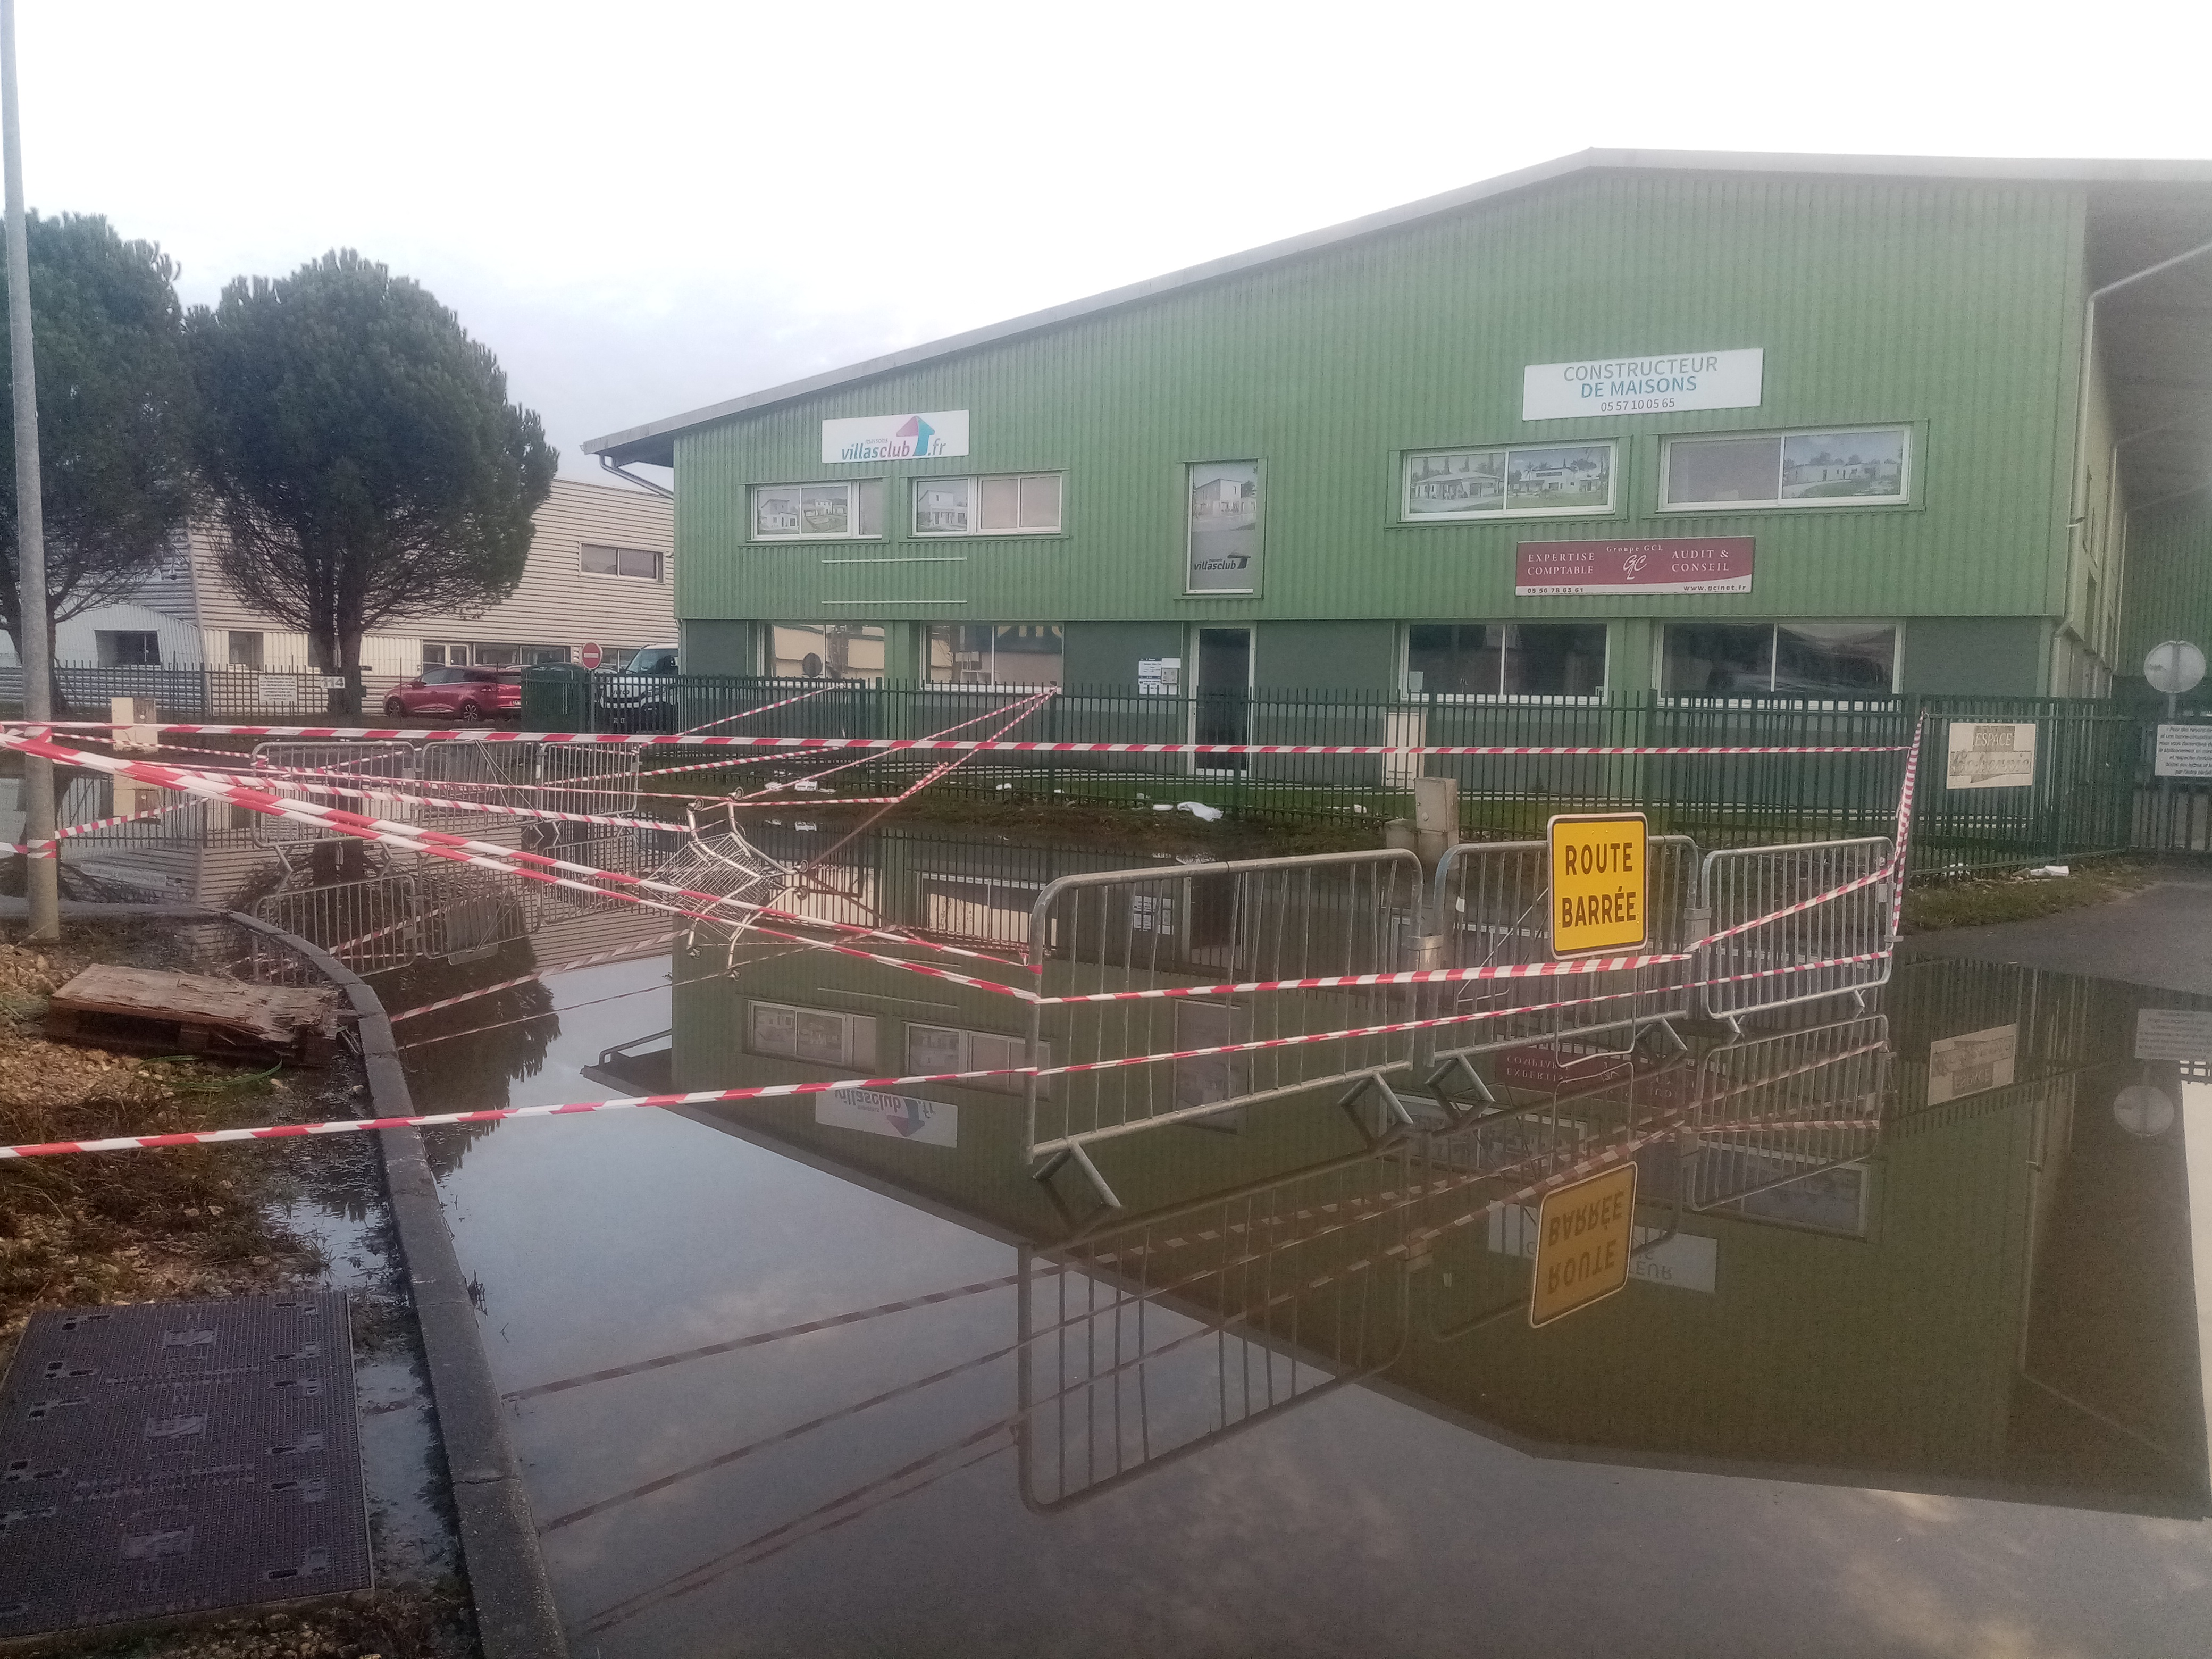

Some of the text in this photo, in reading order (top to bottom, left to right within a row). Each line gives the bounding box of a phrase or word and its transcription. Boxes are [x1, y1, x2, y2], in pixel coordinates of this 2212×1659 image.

[1563, 356, 1718, 381] CONSTRUCTEUR
[1581, 376, 1697, 398] DE MAISONS
[1601, 398, 1674, 412] 05 57 10 05 65
[842, 441, 910, 460] villasclub
[1528, 552, 1595, 562] EXPERTISE
[1672, 549, 1729, 559] AUDIT &
[1194, 560, 1236, 570] villasclub
[1528, 566, 1594, 576] COMPTABLE
[1672, 563, 1729, 572] CONSEIL
[1975, 733, 2013, 747] ESPACE
[1565, 842, 1633, 876] ROUTE
[1562, 886, 1636, 928] BARRÉE
